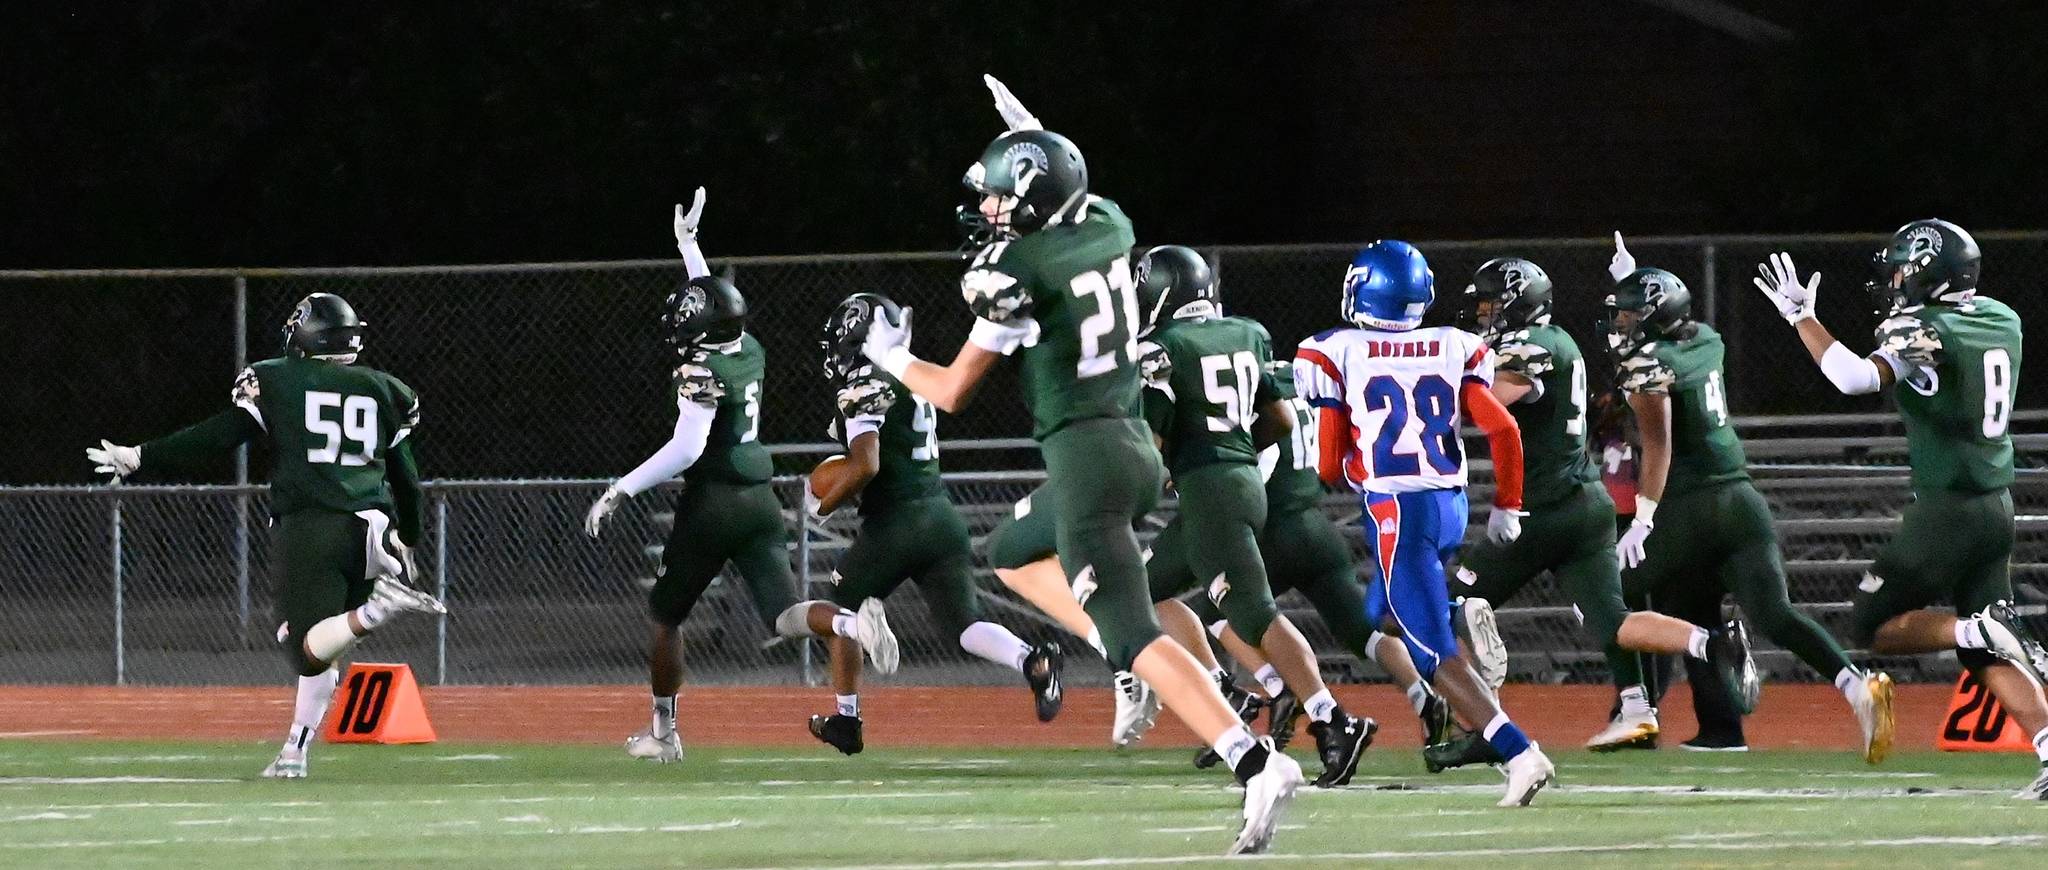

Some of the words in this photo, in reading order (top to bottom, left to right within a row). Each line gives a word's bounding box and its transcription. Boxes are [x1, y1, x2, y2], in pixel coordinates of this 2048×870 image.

[1070, 256, 1139, 378] 21
[1367, 340, 1440, 358] ROYALS
[305, 390, 379, 467] 59
[1200, 350, 1259, 433] 50
[1363, 374, 1463, 478] 28
[1982, 348, 2010, 439] 8
[338, 670, 393, 735] 10
[1943, 667, 2008, 743] 20
